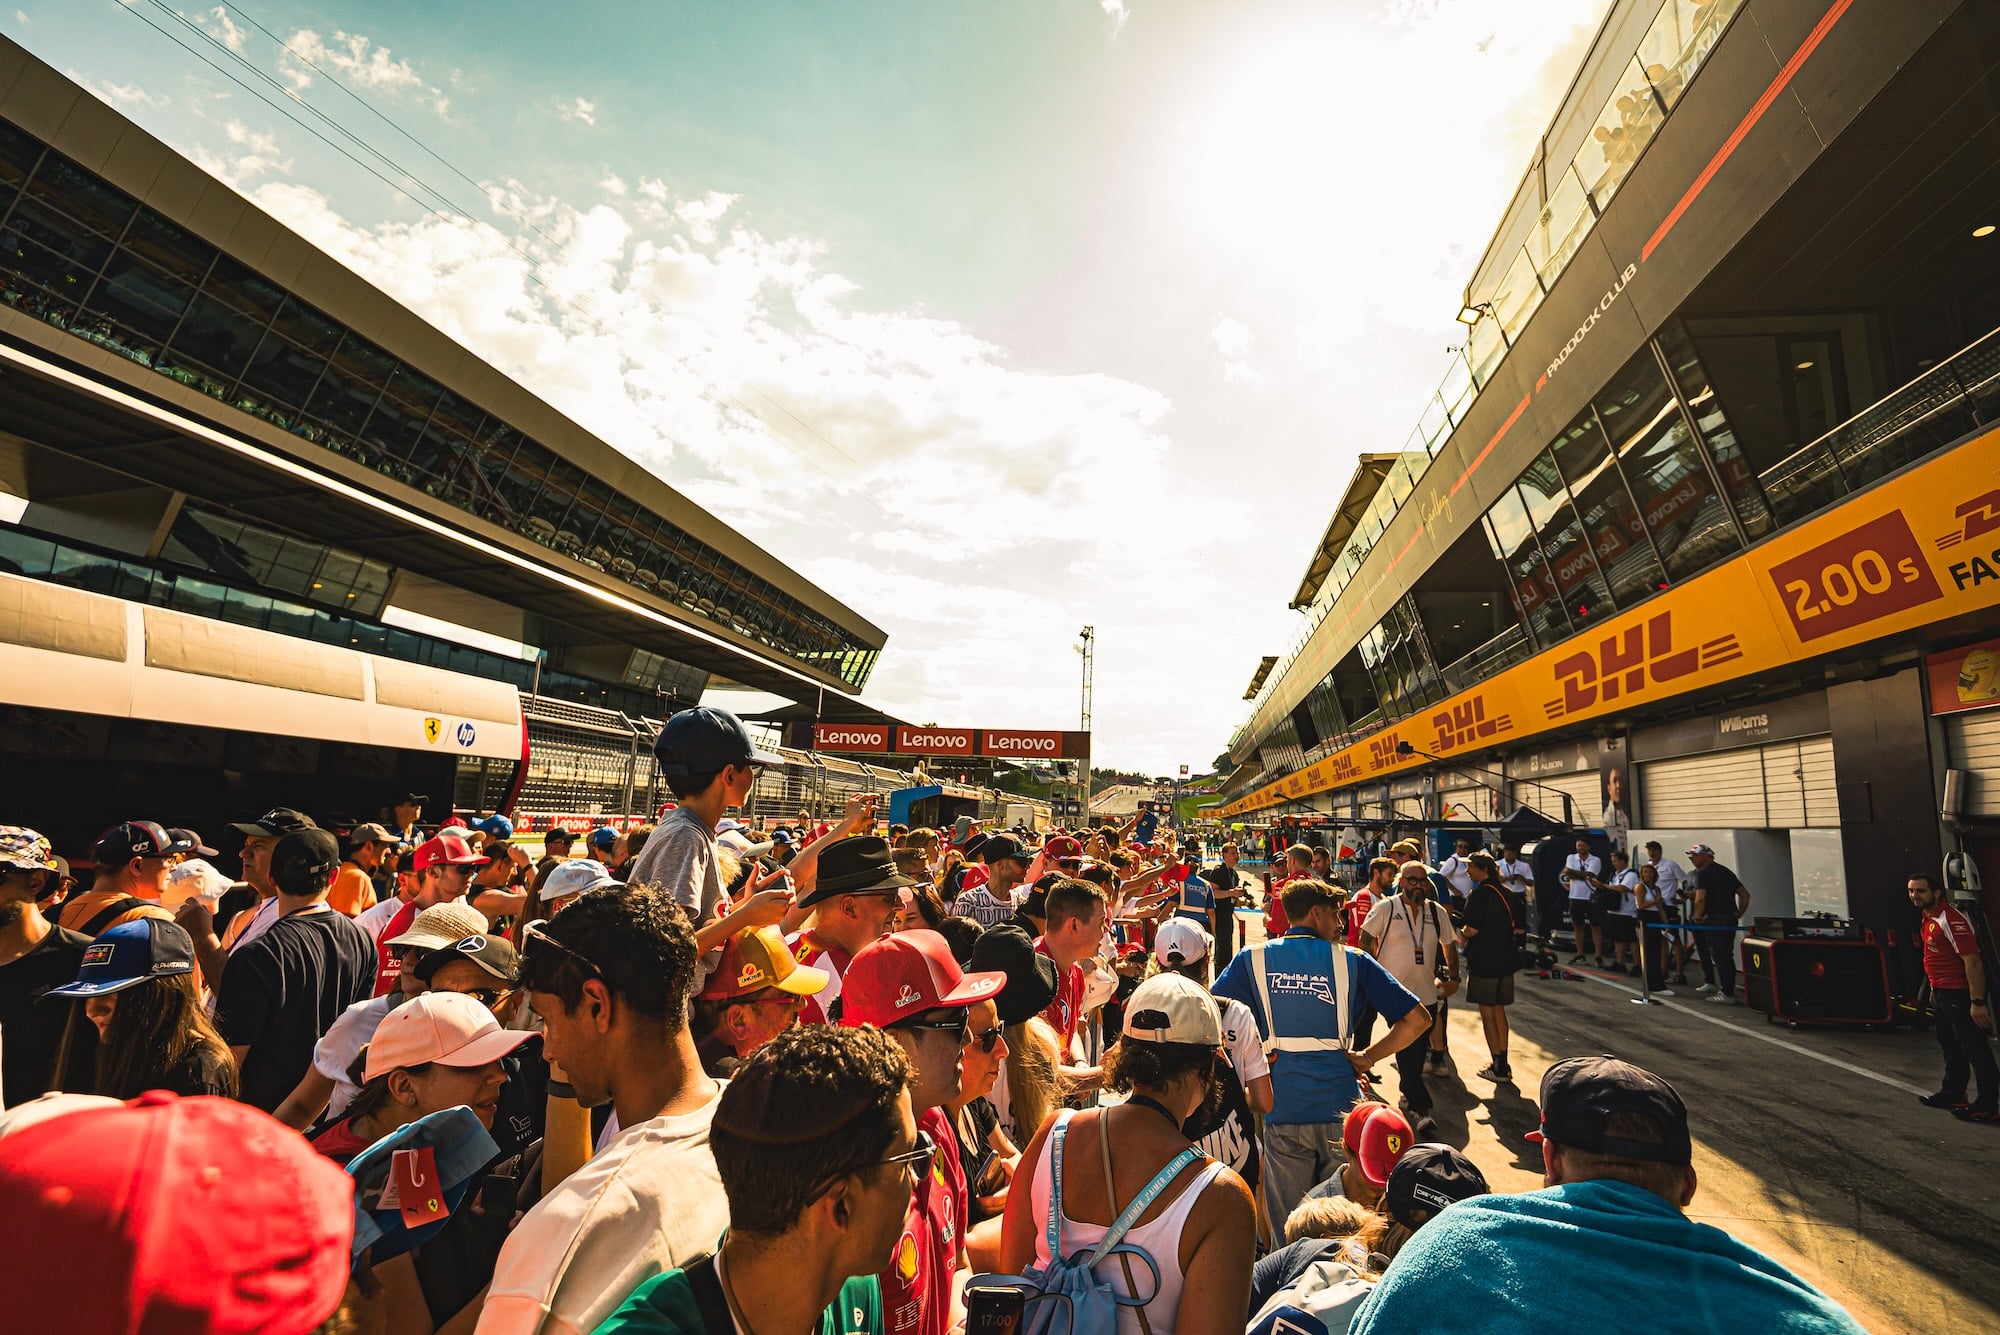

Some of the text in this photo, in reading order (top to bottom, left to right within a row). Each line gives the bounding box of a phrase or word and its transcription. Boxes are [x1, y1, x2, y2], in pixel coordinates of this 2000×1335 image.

[1546, 263, 1637, 378] PADDOCK CLUB
[1785, 550, 1892, 621] 2.00
[1554, 610, 1699, 713] DHL
[457, 722, 475, 747] hp
[1433, 695, 1497, 750] DHL
[1720, 714, 1768, 733] Williams
[1754, 727, 1769, 736] TEAM
[819, 728, 882, 746] Lenovo
[902, 731, 967, 748] Lenovo
[988, 734, 1056, 751] Lenovo
[1370, 732, 1407, 772] DHL
[1333, 754, 1358, 781] DHL
[1540, 760, 1563, 770] ALBON
[555, 817, 591, 834] Lenovo
[152, 961, 190, 969] ALPHATAURI
[970, 977, 996, 993] 16
[1193, 1109, 1243, 1166] NIKE
[1167, 1154, 1188, 1178] J'AIMER
[1145, 1176, 1167, 1201] J'AIMER
[1048, 1206, 1057, 1236] J'AIMER
[1124, 1200, 1145, 1226] J'AIMER
[980, 1313, 1012, 1327] 17:00
